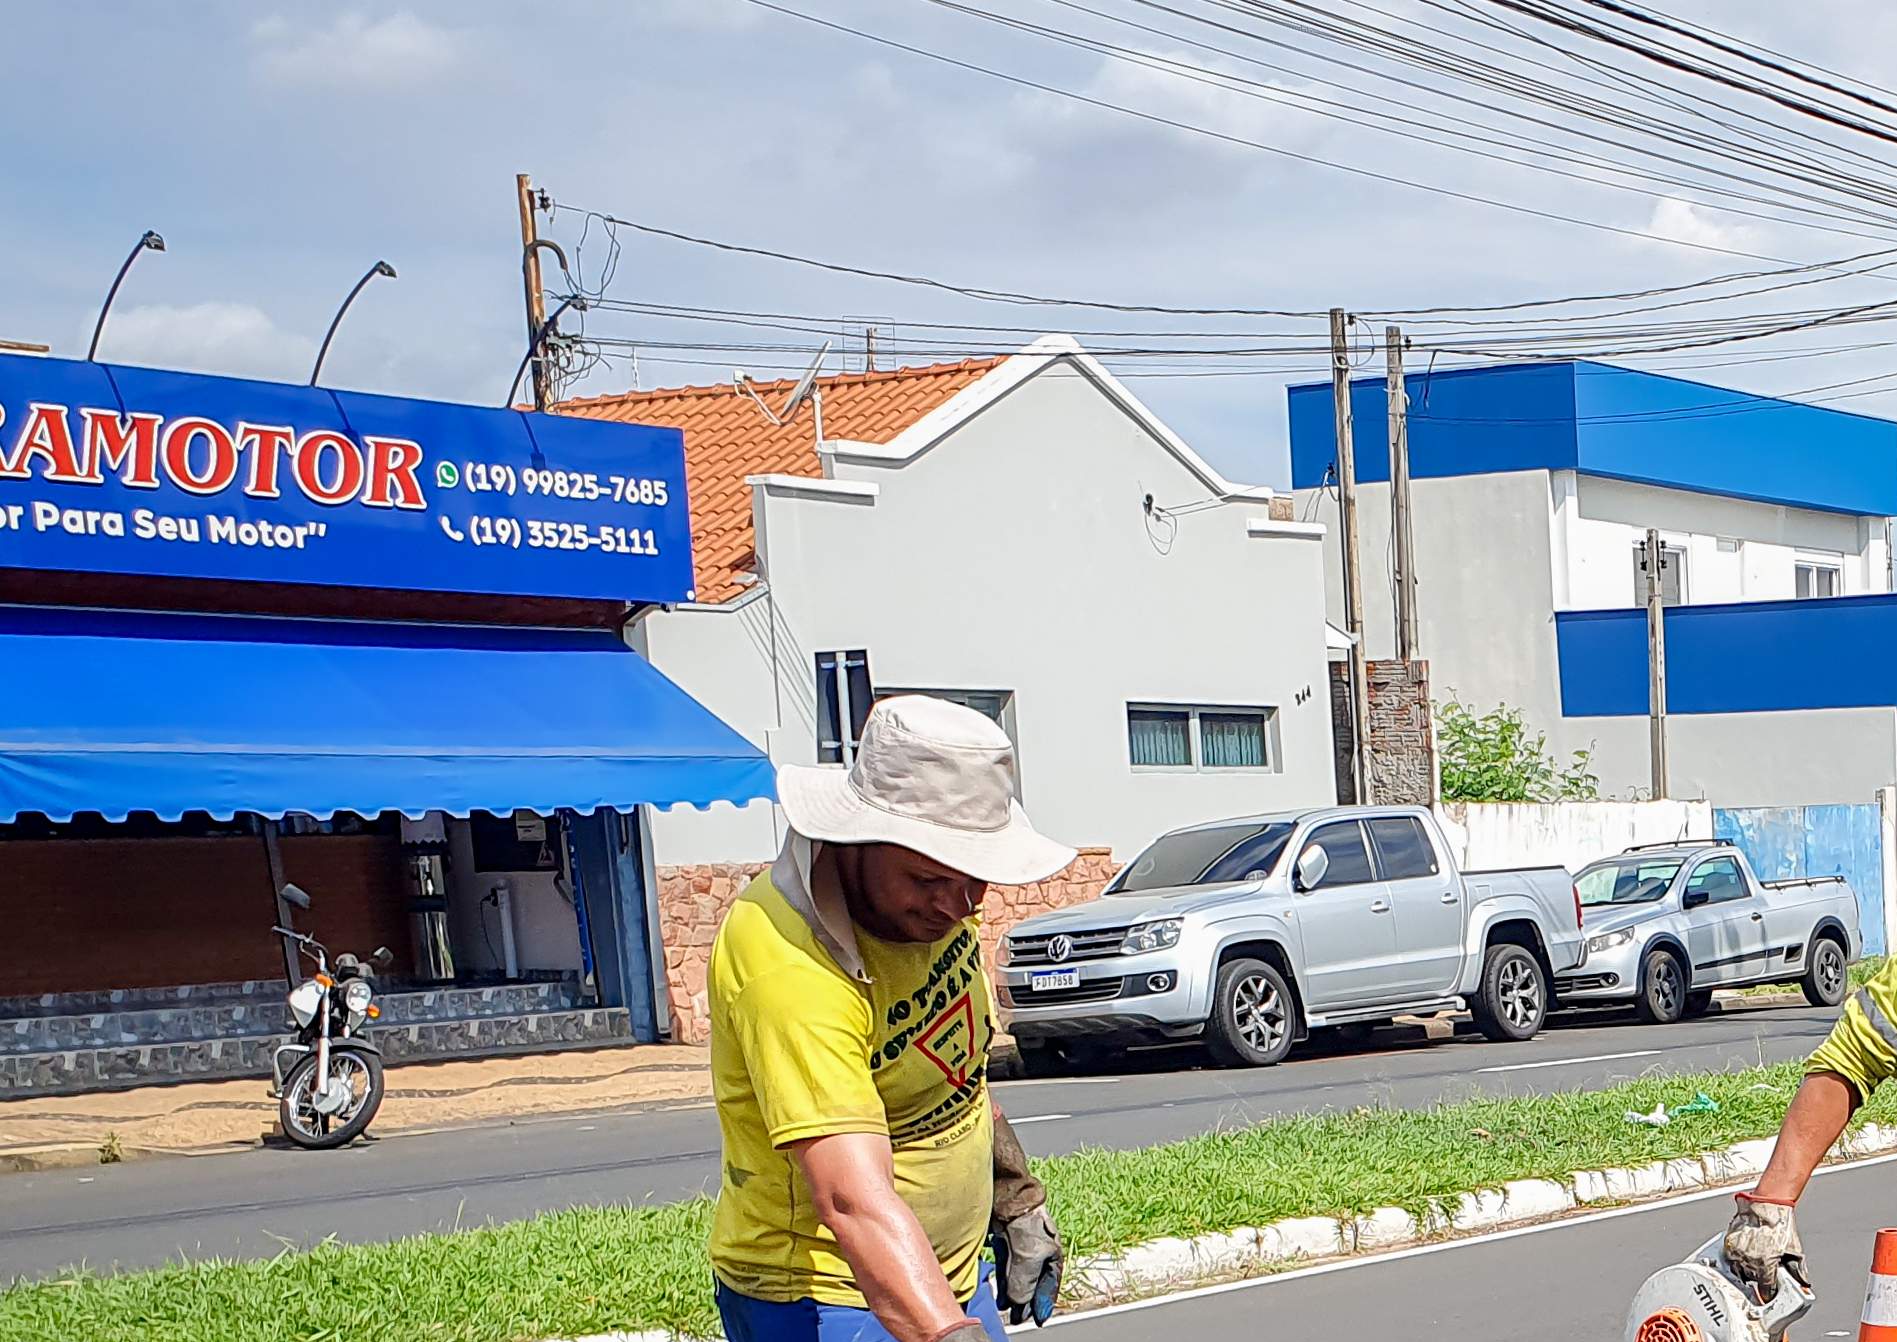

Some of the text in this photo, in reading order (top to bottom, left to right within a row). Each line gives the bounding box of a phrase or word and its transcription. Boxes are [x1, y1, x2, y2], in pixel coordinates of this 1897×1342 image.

[464, 461, 669, 506] (19) 99825-7685
[32, 501, 125, 537] Para
[133, 508, 200, 542] Seu
[470, 515, 660, 556] (19) 3525-5111
[1693, 1283, 1724, 1327] STIHL
